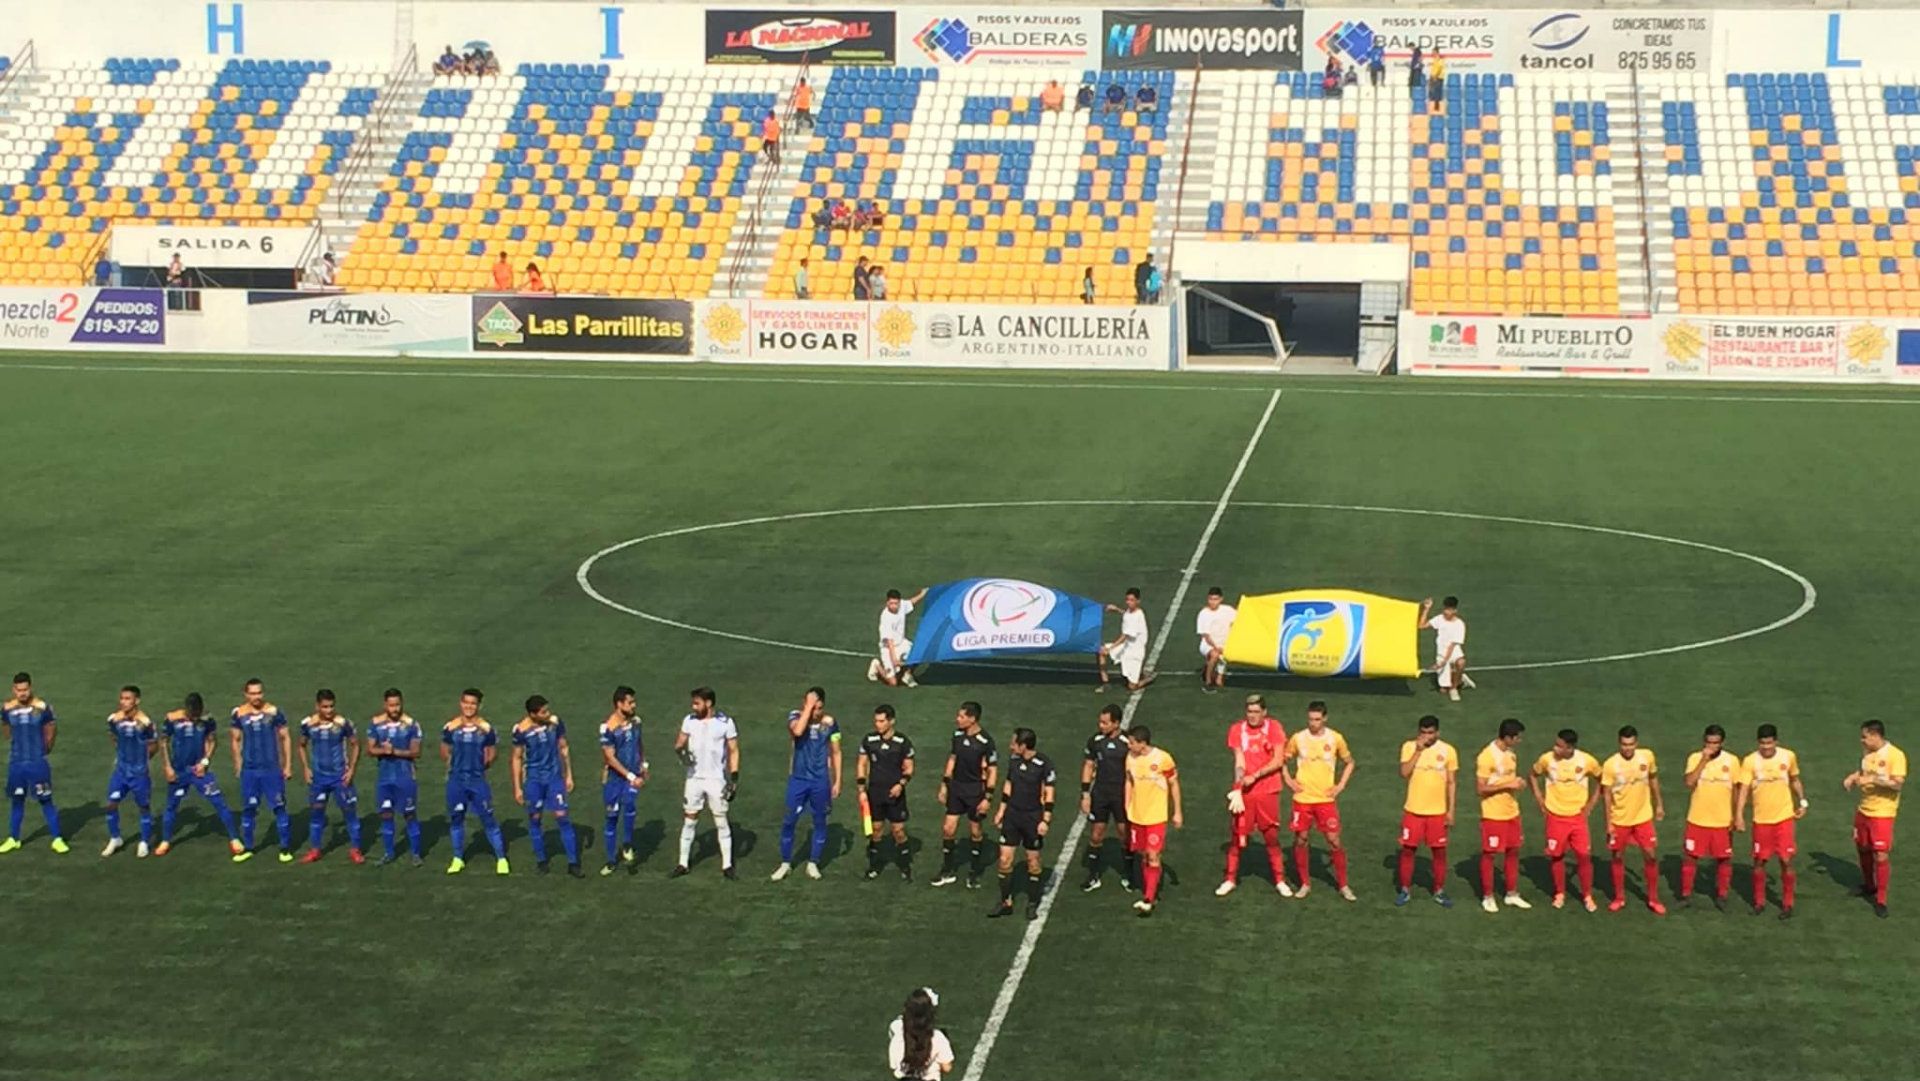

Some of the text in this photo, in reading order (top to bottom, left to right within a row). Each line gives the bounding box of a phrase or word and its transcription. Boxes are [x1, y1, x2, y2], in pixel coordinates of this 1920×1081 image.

[977, 15, 1082, 25] PISOS Y AZULEJOS
[1382, 18, 1488, 27] PISOS Y AZULEJOS
[1612, 18, 1706, 30] CONCRETAMOS TUS
[207, 4, 243, 54] H
[725, 21, 872, 47] LA NACIONAL
[969, 31, 1087, 46] BALDERAS
[1374, 35, 1494, 49] BALDERAS
[1644, 34, 1673, 46] IDEAS
[1827, 14, 1861, 67] L
[1520, 54, 1594, 69] tancol
[1618, 51, 1696, 69] 825 95 65
[159, 236, 273, 253] SALIDA 6
[95, 302, 158, 315] PEDIDOS:
[752, 310, 866, 320] SERVICIOS FINANCIEROS
[4, 323, 49, 338] Norte
[84, 318, 160, 334] 819-37-20
[487, 318, 514, 331] TACO
[528, 314, 684, 337] Las Parrillitas
[760, 321, 859, 330] Y GASOLINERAS
[957, 309, 1150, 339] LA CANCILLERÍA
[1714, 325, 1835, 338] EL BUEN HOGAR
[759, 332, 858, 350] HOGAR
[1711, 340, 1835, 352] RESTAURANTE BAR Y
[1496, 346, 1561, 358] Restaurant
[1757, 356, 1773, 367] DE
[1777, 356, 1835, 368] EVENTOS
[956, 633, 1050, 648] LIGA PREMIER
